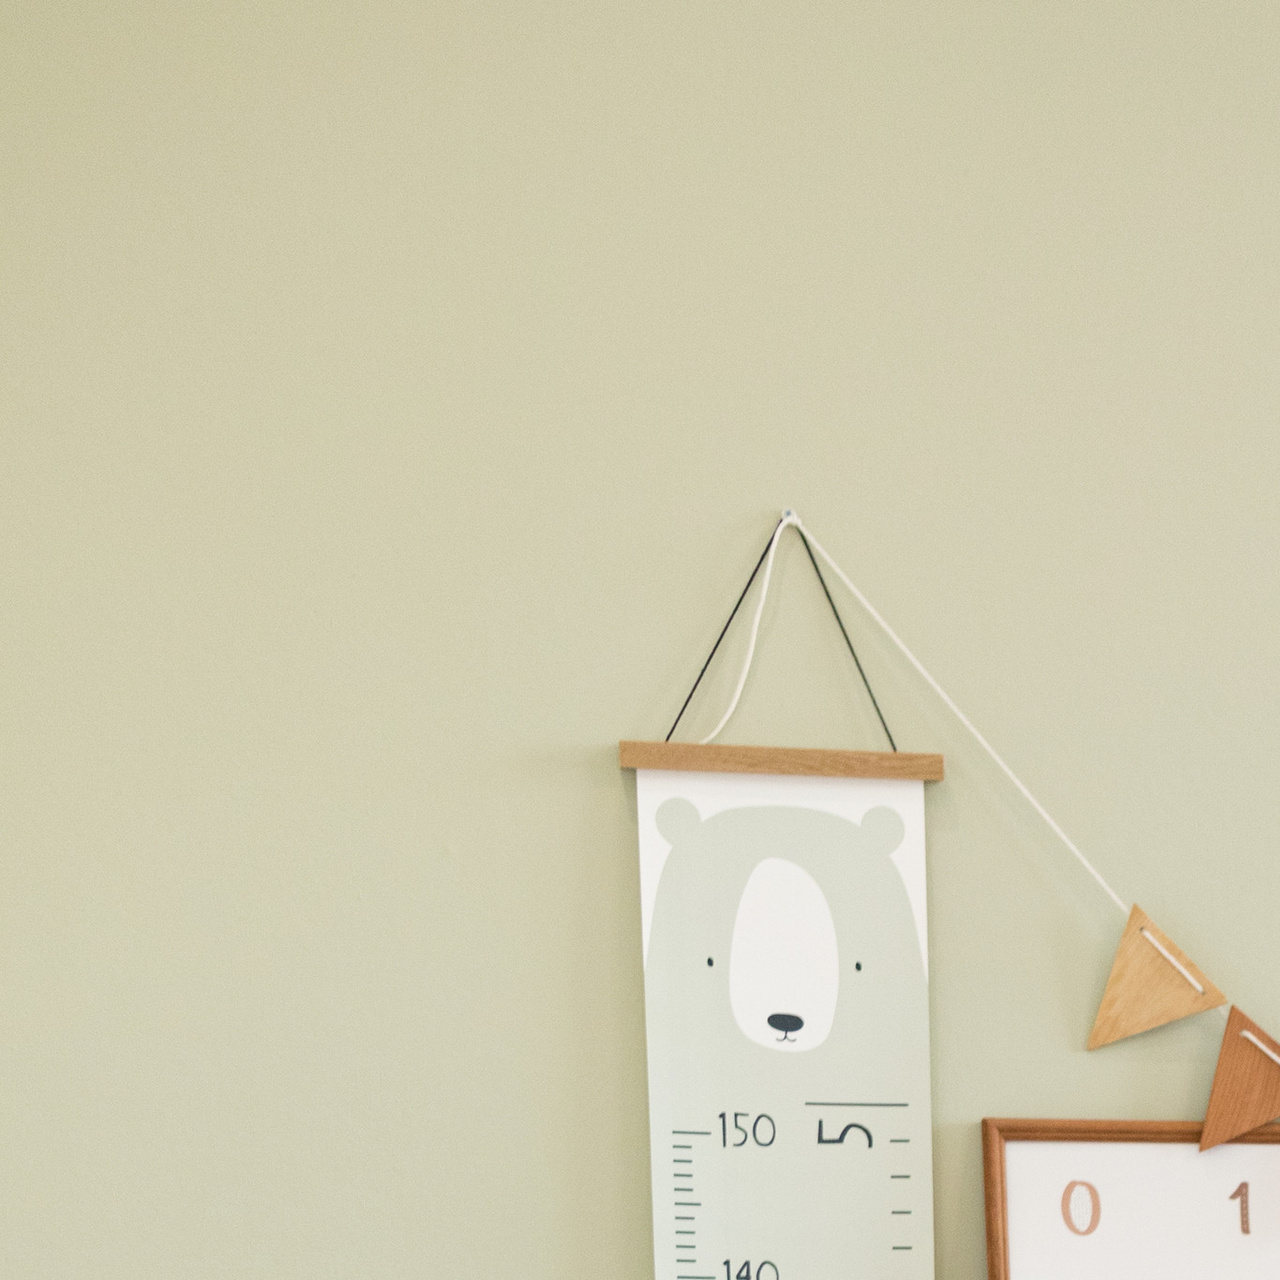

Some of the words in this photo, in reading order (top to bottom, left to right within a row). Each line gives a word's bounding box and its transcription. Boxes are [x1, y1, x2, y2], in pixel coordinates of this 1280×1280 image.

[718, 1111, 777, 1148] 150
[817, 1119, 874, 1149] 5
[1228, 1181, 1251, 1236] 1
